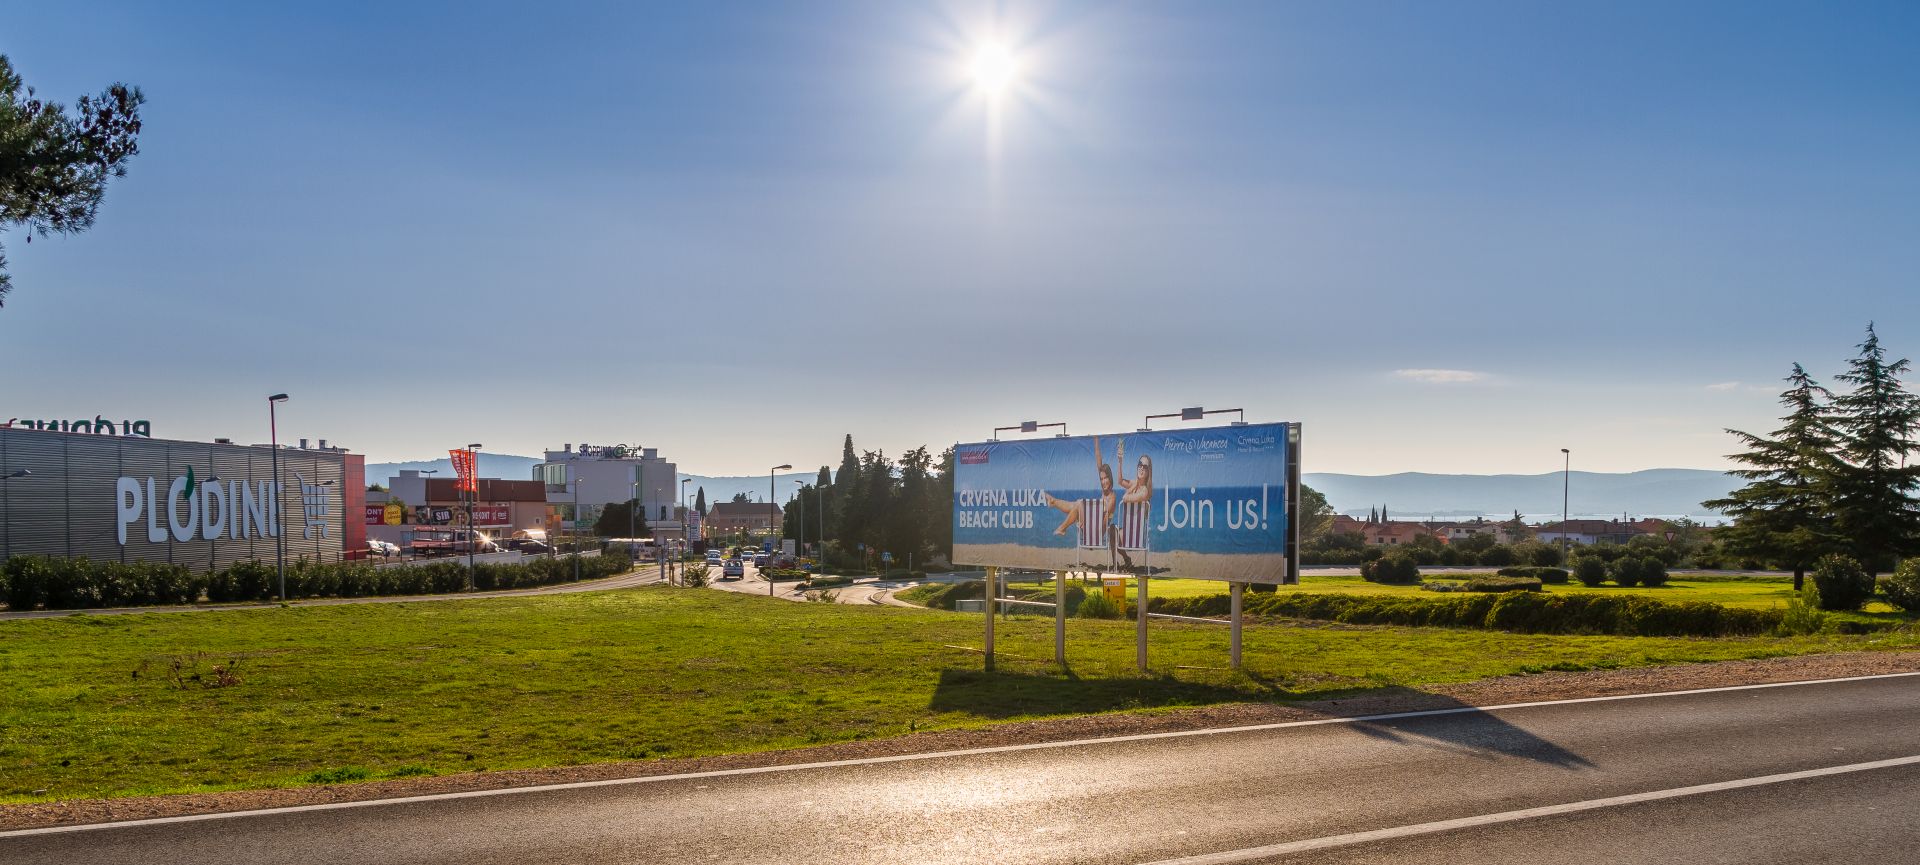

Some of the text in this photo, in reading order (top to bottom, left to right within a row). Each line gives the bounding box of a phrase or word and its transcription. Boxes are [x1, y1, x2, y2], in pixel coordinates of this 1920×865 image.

[959, 488, 1047, 507] CRVENA LUKA
[1157, 482, 1268, 532] Join us!
[959, 510, 1034, 528] BEACH CLUB
